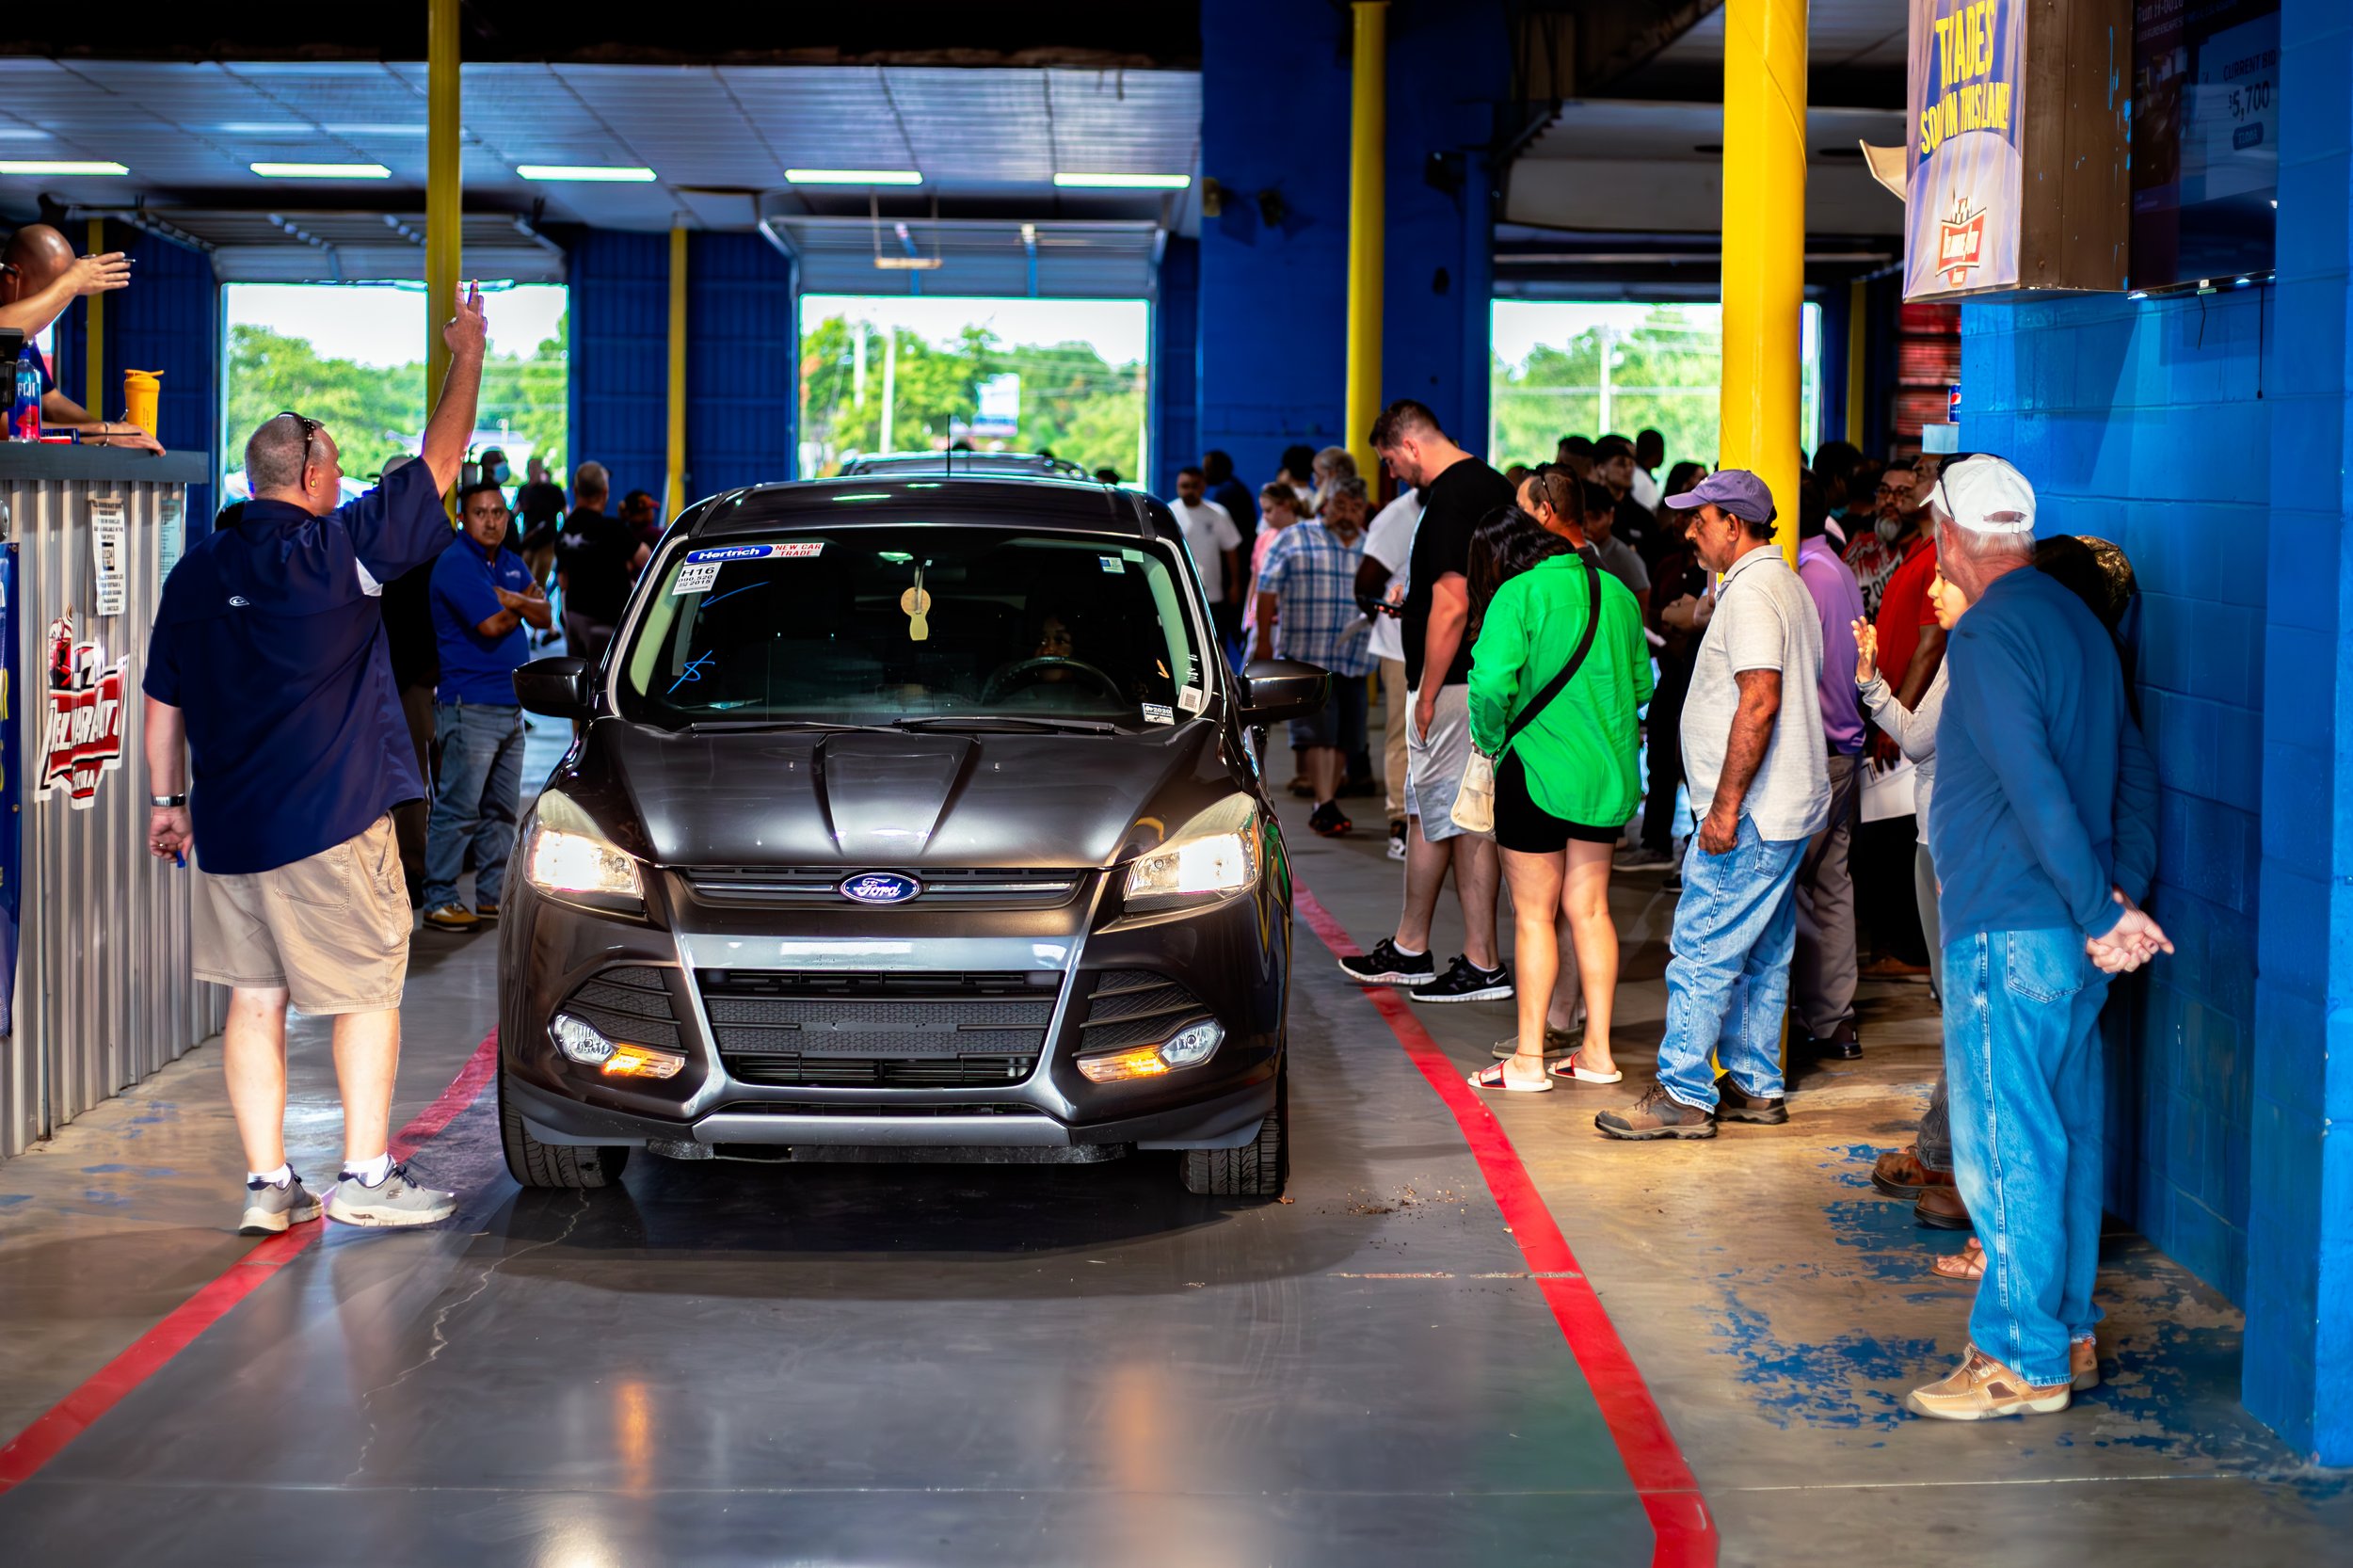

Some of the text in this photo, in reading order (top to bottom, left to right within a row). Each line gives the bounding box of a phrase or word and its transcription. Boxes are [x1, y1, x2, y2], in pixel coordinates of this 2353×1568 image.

[1935, 0, 1995, 89] TADES
[2223, 50, 2277, 82] CURRENT BID
[2229, 81, 2270, 121] $5,700
[698, 548, 760, 560] Hertrich
[681, 567, 715, 577] H16
[853, 877, 902, 897] Ford
